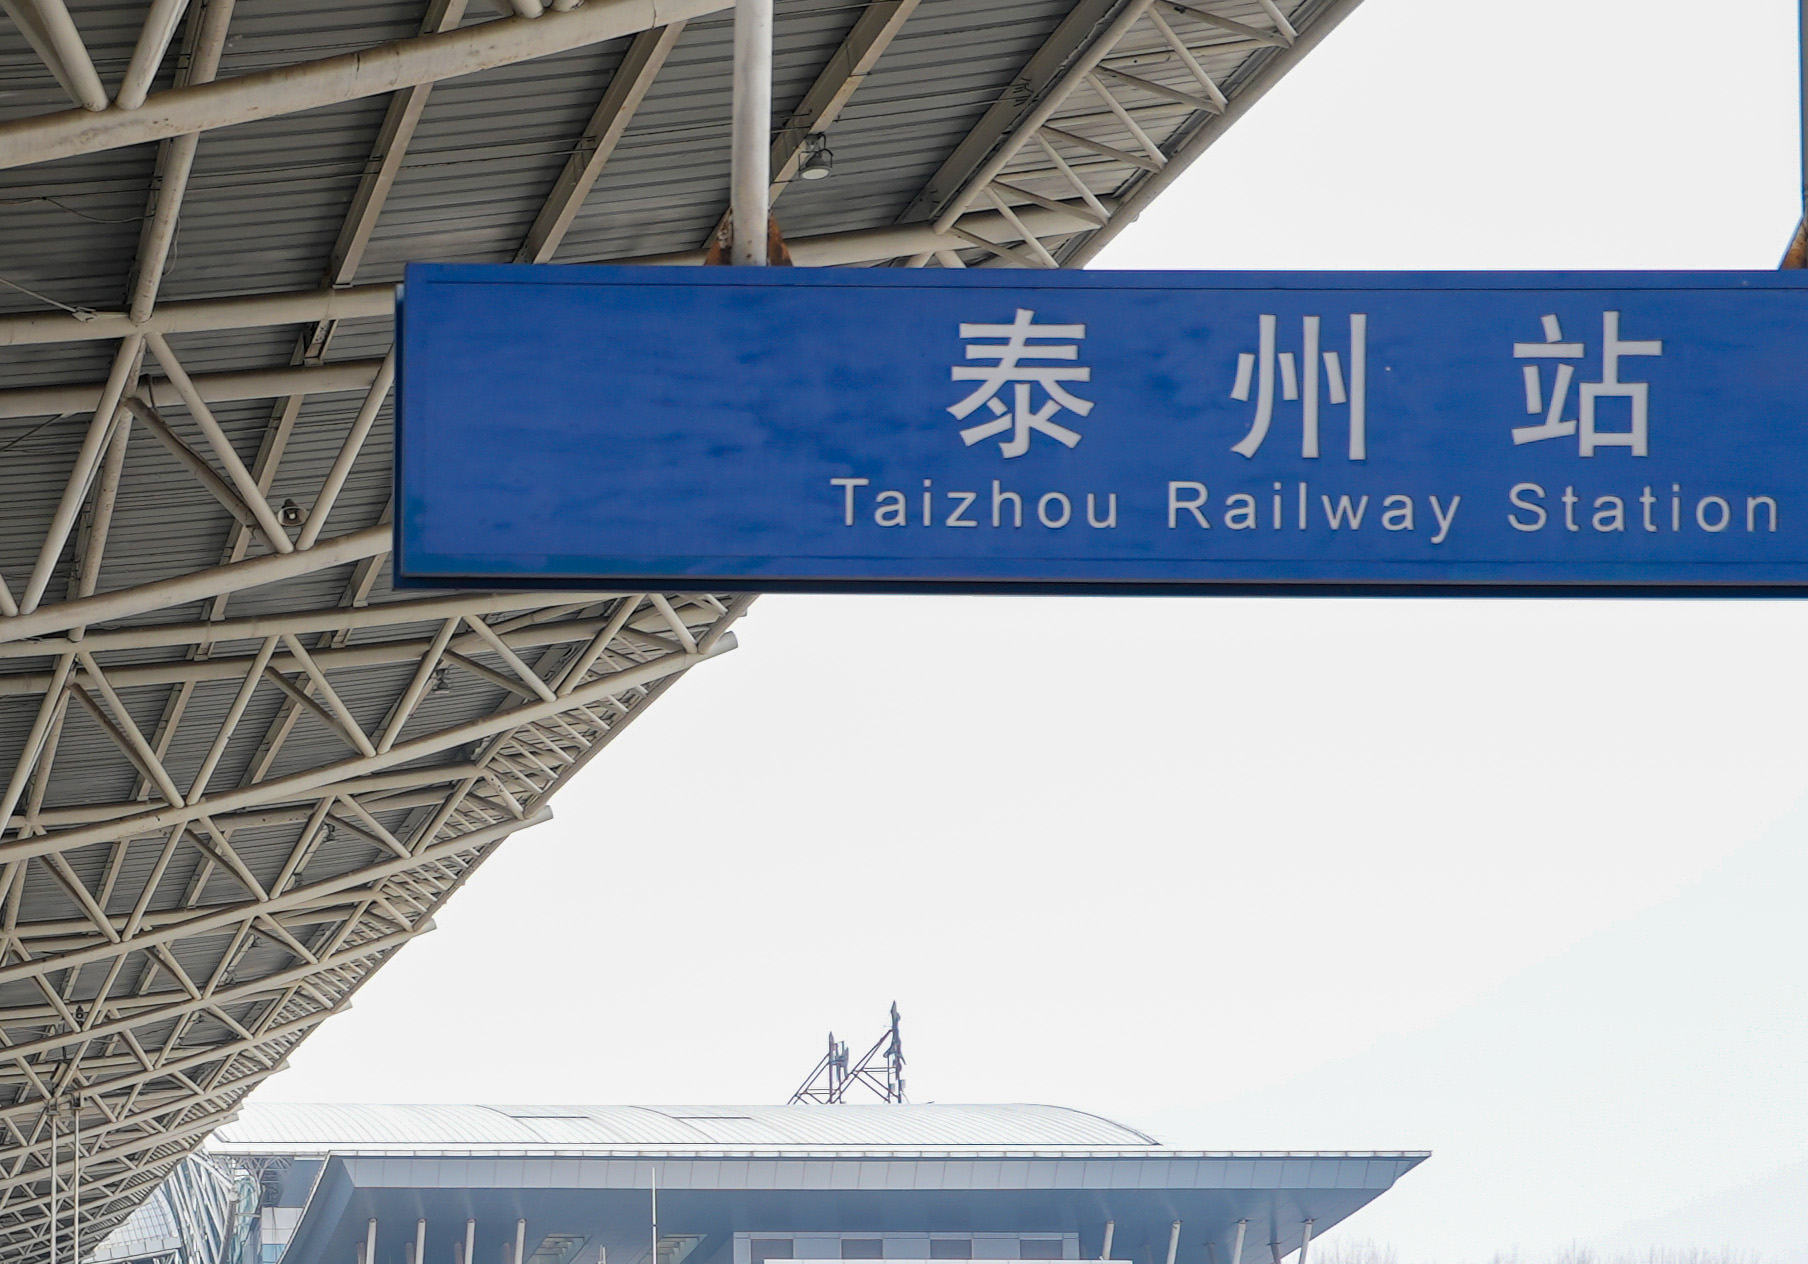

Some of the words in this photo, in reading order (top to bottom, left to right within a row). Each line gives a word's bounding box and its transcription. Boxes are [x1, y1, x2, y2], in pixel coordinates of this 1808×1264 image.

[948, 309, 1660, 459] 泰州站
[831, 479, 1117, 527] Taizhou
[1169, 482, 1459, 543] Railway
[1509, 483, 1775, 531] Station
